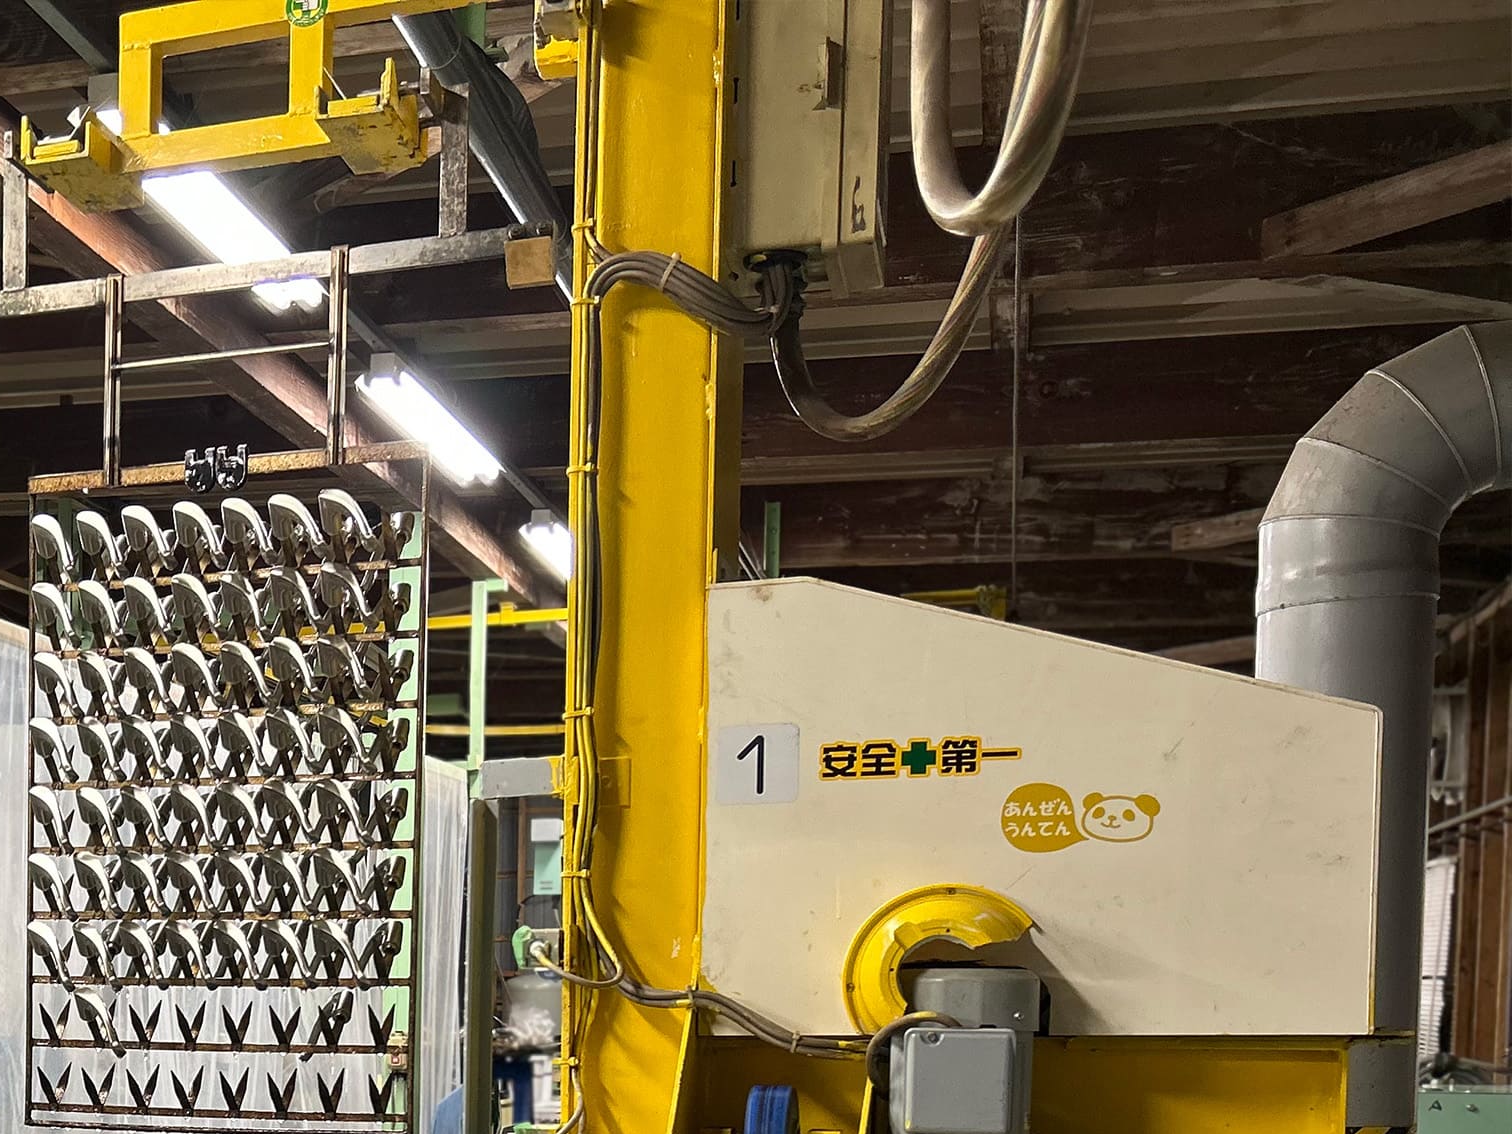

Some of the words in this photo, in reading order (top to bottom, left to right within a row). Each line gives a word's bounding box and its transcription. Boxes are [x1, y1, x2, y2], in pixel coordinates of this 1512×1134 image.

[736, 734, 765, 795] 1
[1004, 798, 1072, 817] あんぜん
[1005, 821, 1071, 837] うんてん
